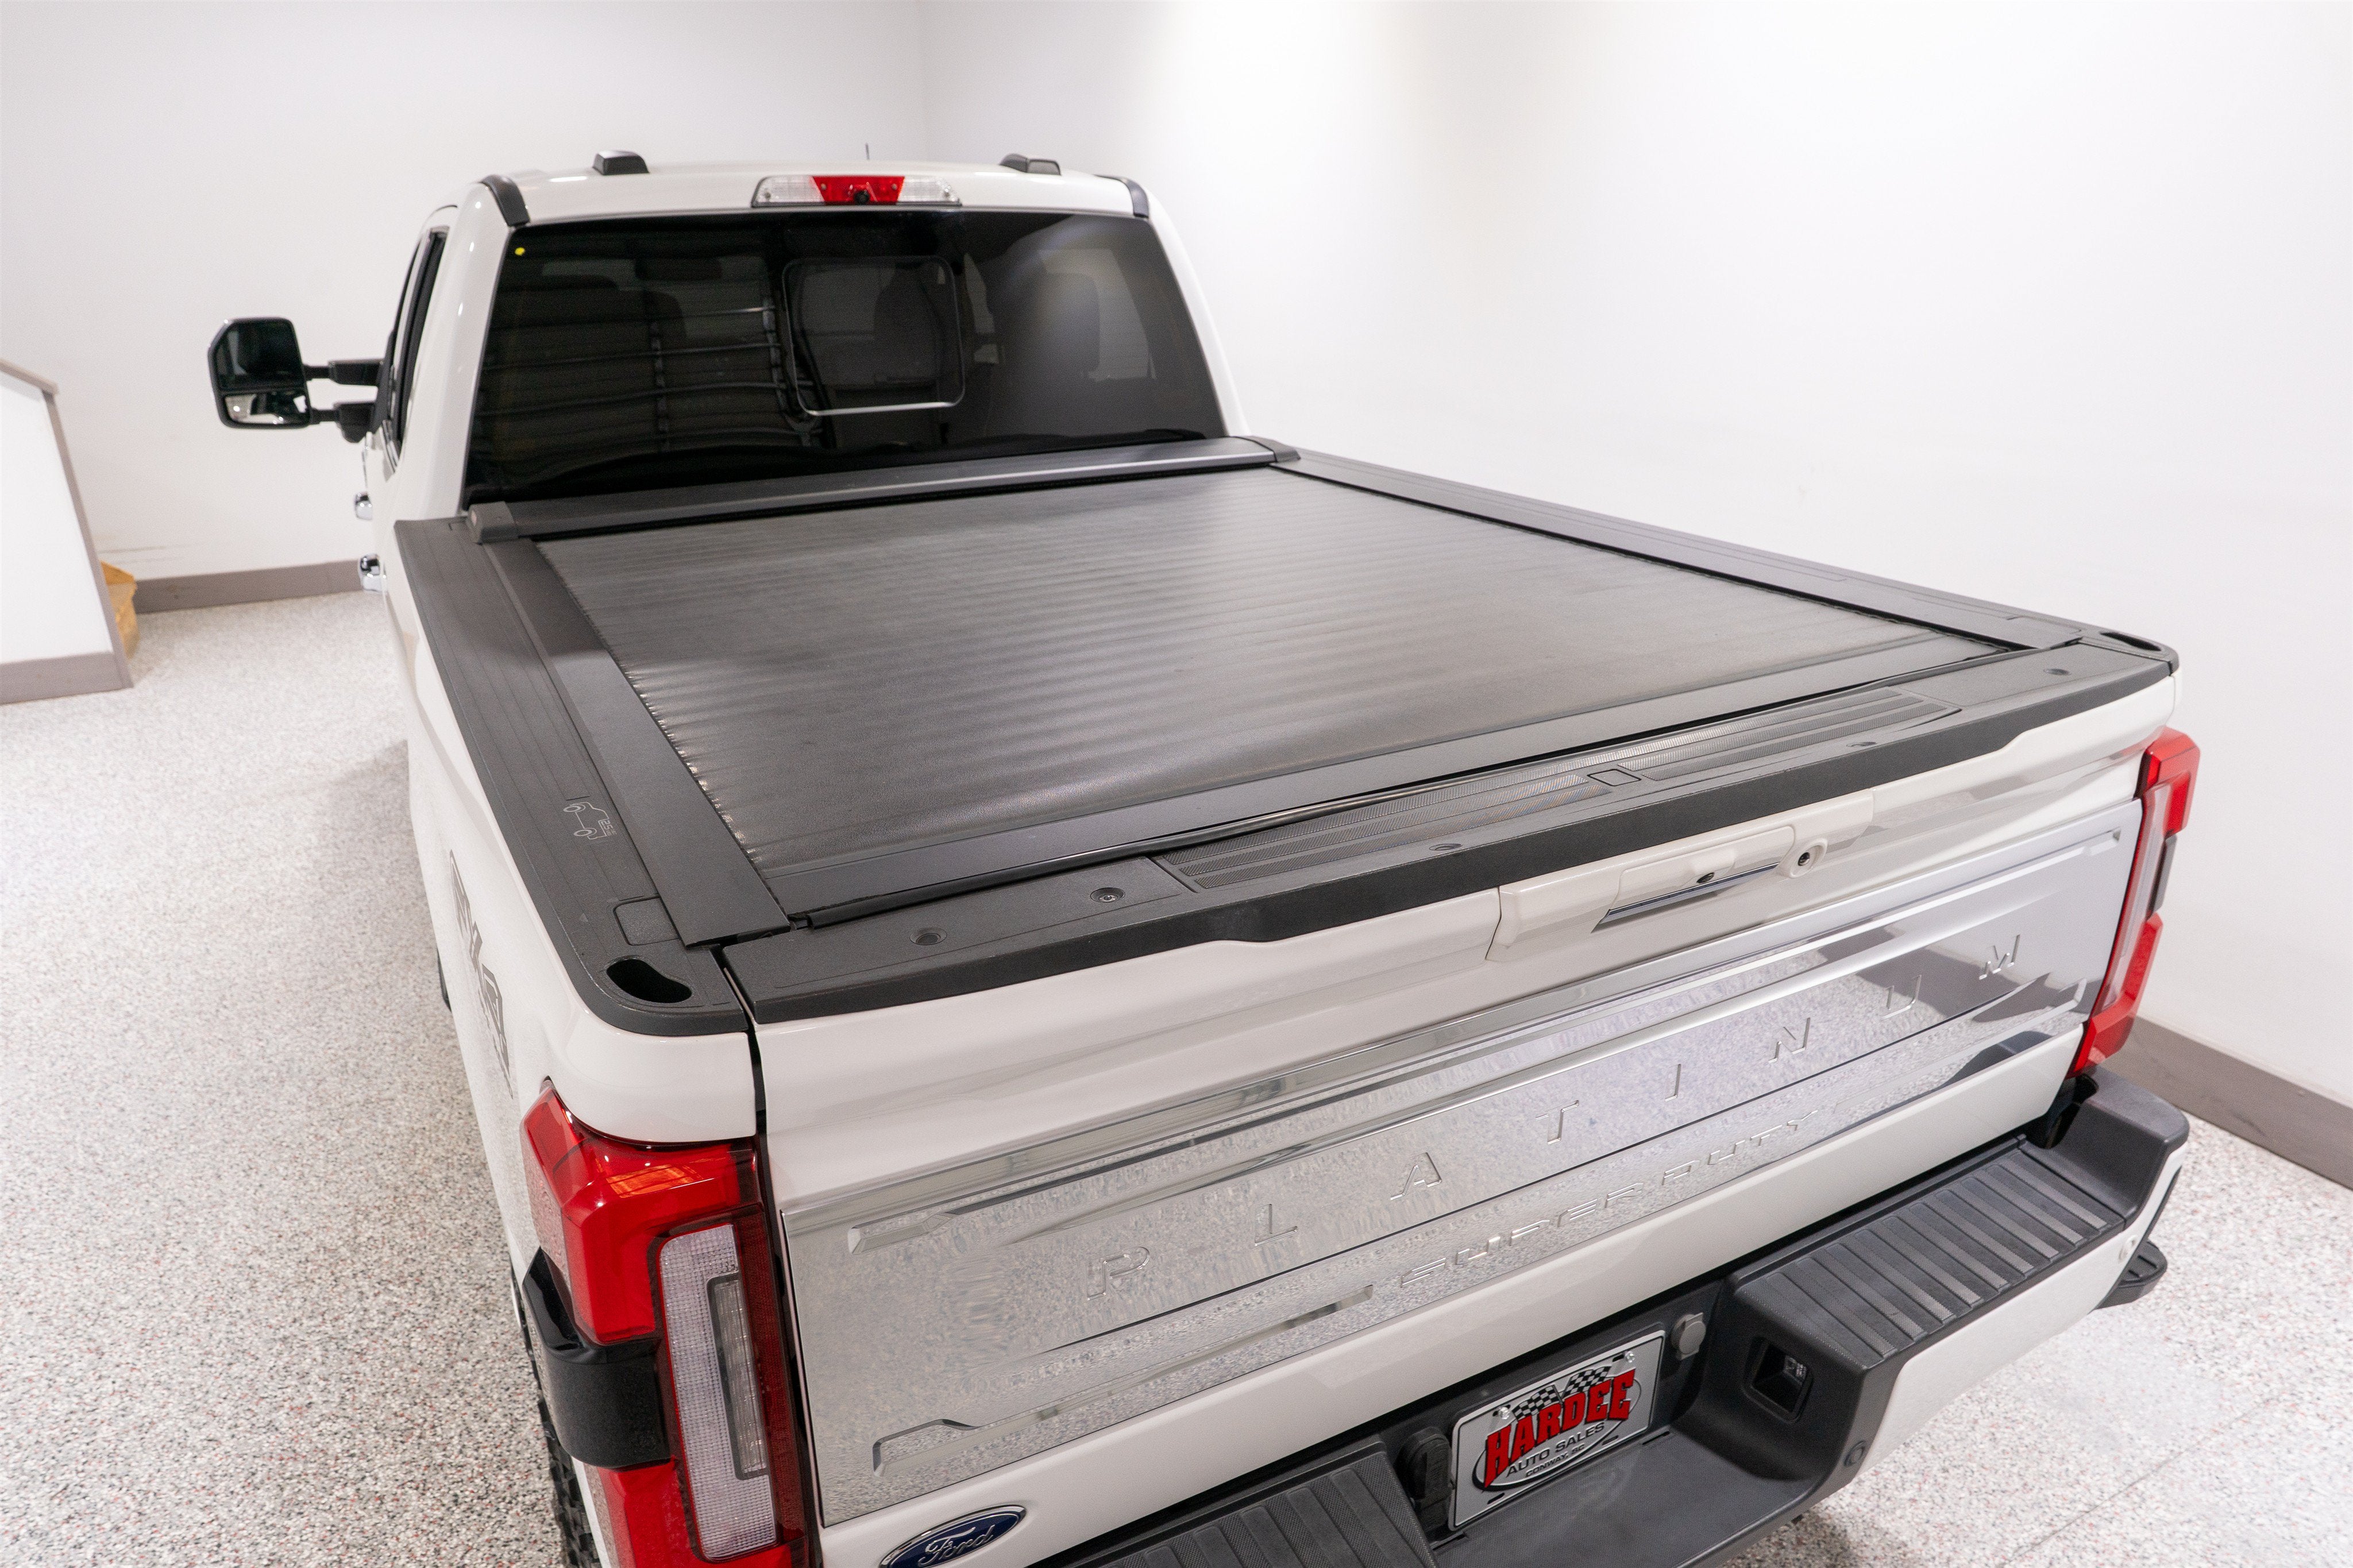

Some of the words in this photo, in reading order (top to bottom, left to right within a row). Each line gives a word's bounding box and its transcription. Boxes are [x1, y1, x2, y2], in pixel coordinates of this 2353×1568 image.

[1086, 934, 2021, 1301] PLATINUM
[1400, 1183, 1644, 1288] SUPER
[1662, 1110, 1819, 1186] DUTY
[1483, 1368, 1636, 1489] HARDEE
[1506, 1449, 1550, 1478] AUTO
[1554, 1422, 1605, 1454] SALES
[1525, 1451, 1569, 1478] CONWAY,
[1571, 1443, 1586, 1457] SC
[918, 1524, 996, 1567] Ford
